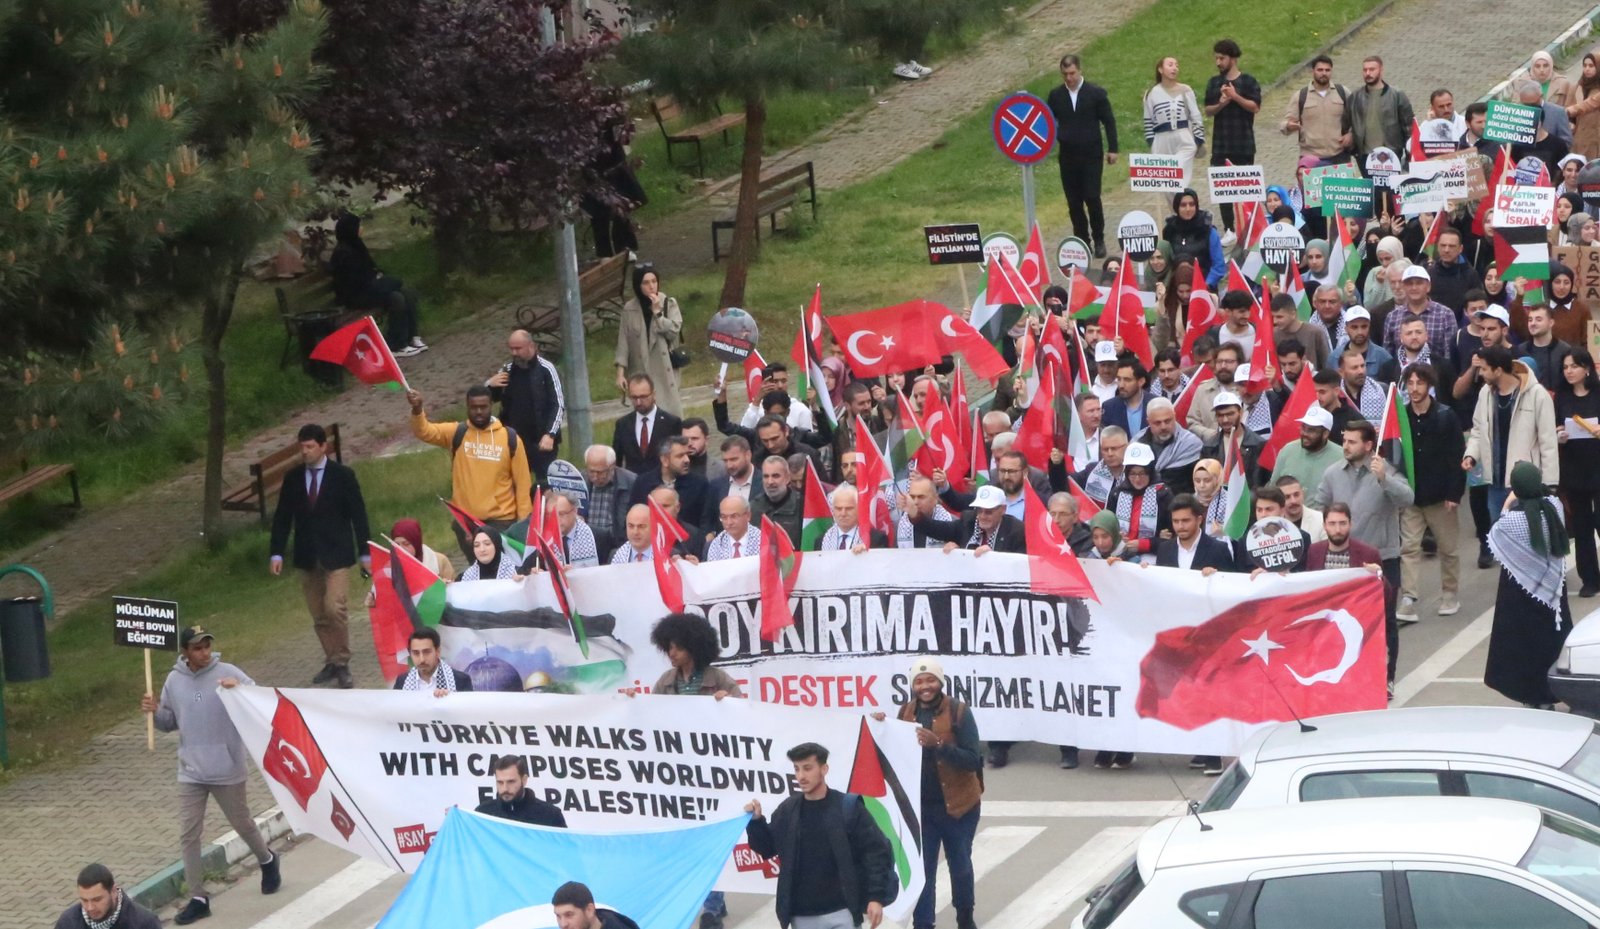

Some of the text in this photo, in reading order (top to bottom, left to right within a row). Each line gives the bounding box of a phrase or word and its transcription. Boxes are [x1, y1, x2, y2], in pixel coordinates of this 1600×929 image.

[1494, 104, 1535, 119] DÜNYANIN
[1486, 128, 1535, 144] ÖLDÜRÜLDÜ
[1136, 168, 1178, 178] BAŞKENTİ
[1133, 178, 1183, 188] KUDÜS'TÜR.
[1213, 179, 1261, 188] SOYKIRIMA
[1214, 188, 1262, 197] ORTAK OLMA!
[1335, 194, 1371, 203] ADALETTEN
[1334, 202, 1362, 210] TARAFIZ.
[1506, 213, 1538, 226] İSRAİL
[929, 232, 978, 243] FİLİSTİN'DE
[1123, 237, 1155, 253] HAYIR!
[1264, 236, 1300, 248] SOYKIRIMA
[930, 245, 963, 254] KATLİAM
[964, 244, 980, 252] VAR
[1586, 251, 1600, 298] GAZA
[1258, 539, 1276, 548] KATİL
[1261, 550, 1298, 568] DEFOL
[116, 603, 174, 619] MÜSLÜMAN
[116, 619, 175, 633] ZULME BOYUN
[684, 595, 1072, 658] OYKIRIMA HAYIR!
[127, 630, 166, 645] EĞMEZ!
[759, 674, 879, 708] DESTEK
[891, 668, 1034, 709] SNİZME
[1039, 680, 1121, 718] LANET
[397, 720, 773, 762] "TÜRKİYE WALKS IN UNITY
[379, 752, 459, 777] WITH
[628, 760, 802, 796] WORLDWIDE
[544, 787, 719, 821] PALESTINE!"
[397, 829, 426, 849] #SAY
